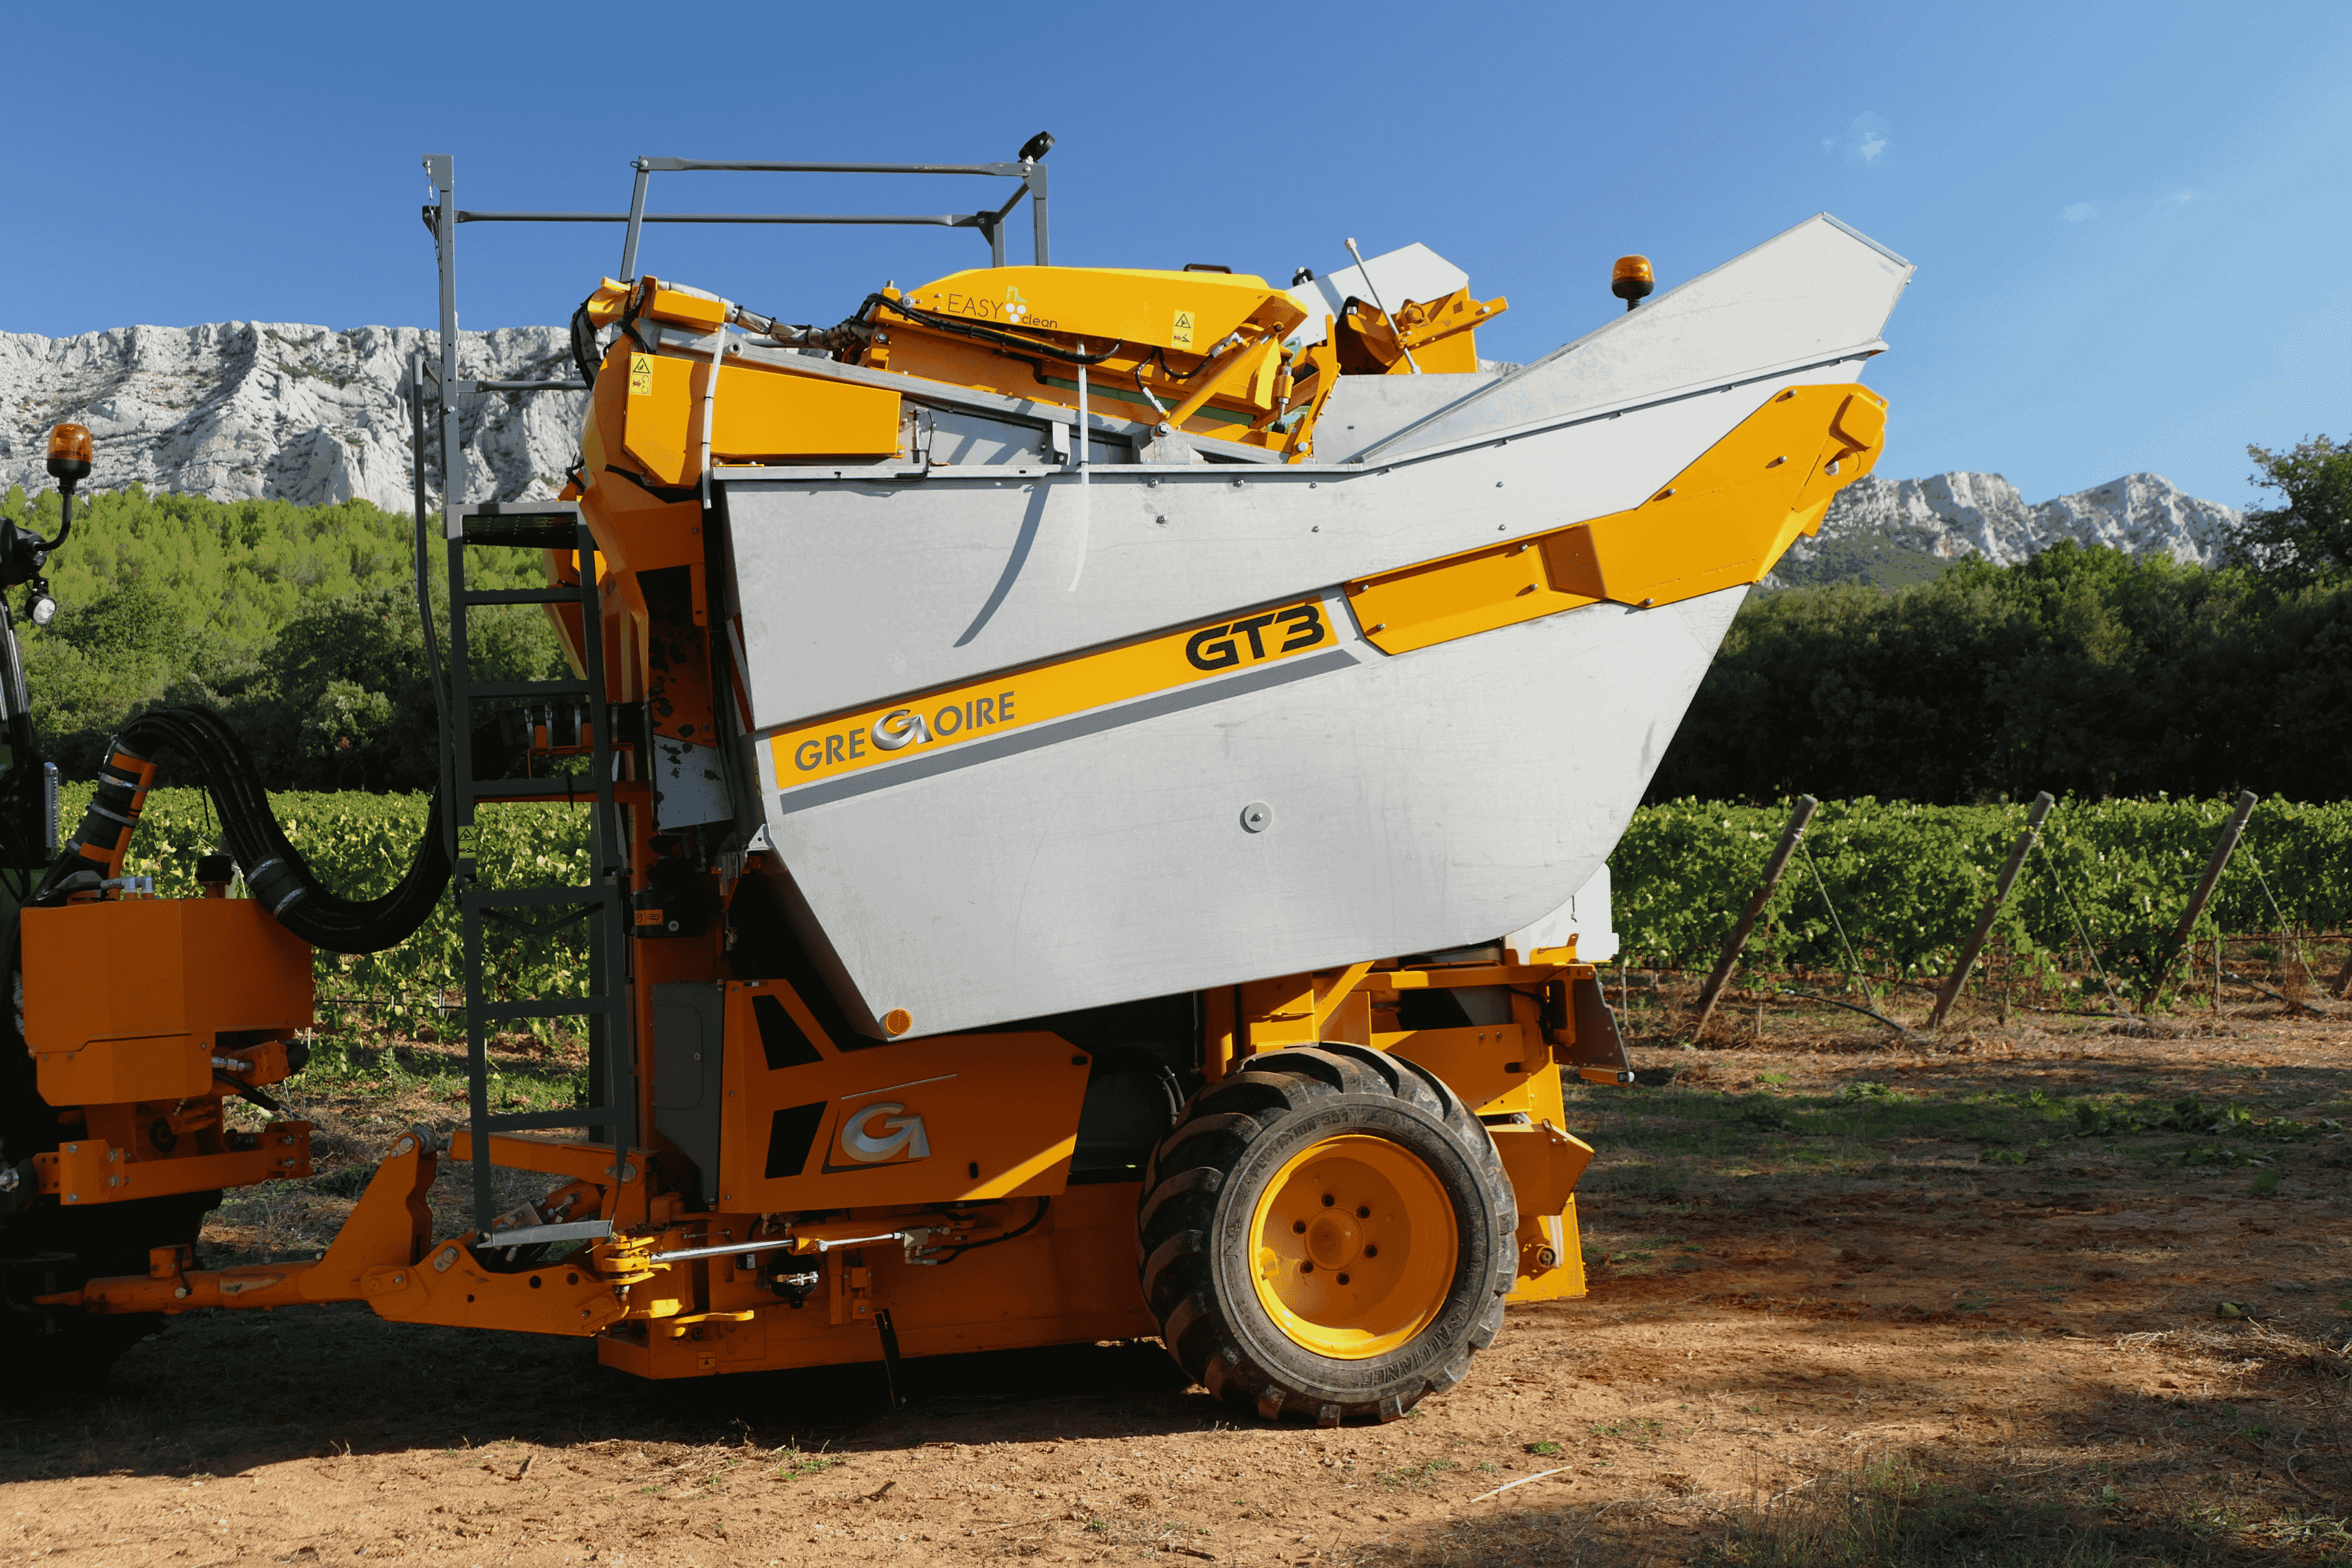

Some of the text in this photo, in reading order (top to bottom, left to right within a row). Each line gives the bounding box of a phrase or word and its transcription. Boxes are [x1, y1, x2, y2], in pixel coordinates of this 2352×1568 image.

[948, 293, 1058, 329] EASY clean
[1186, 605, 1325, 671] GT3
[794, 690, 1016, 772] GREGOIRE
[1362, 1325, 1454, 1388] ALLIANCE
